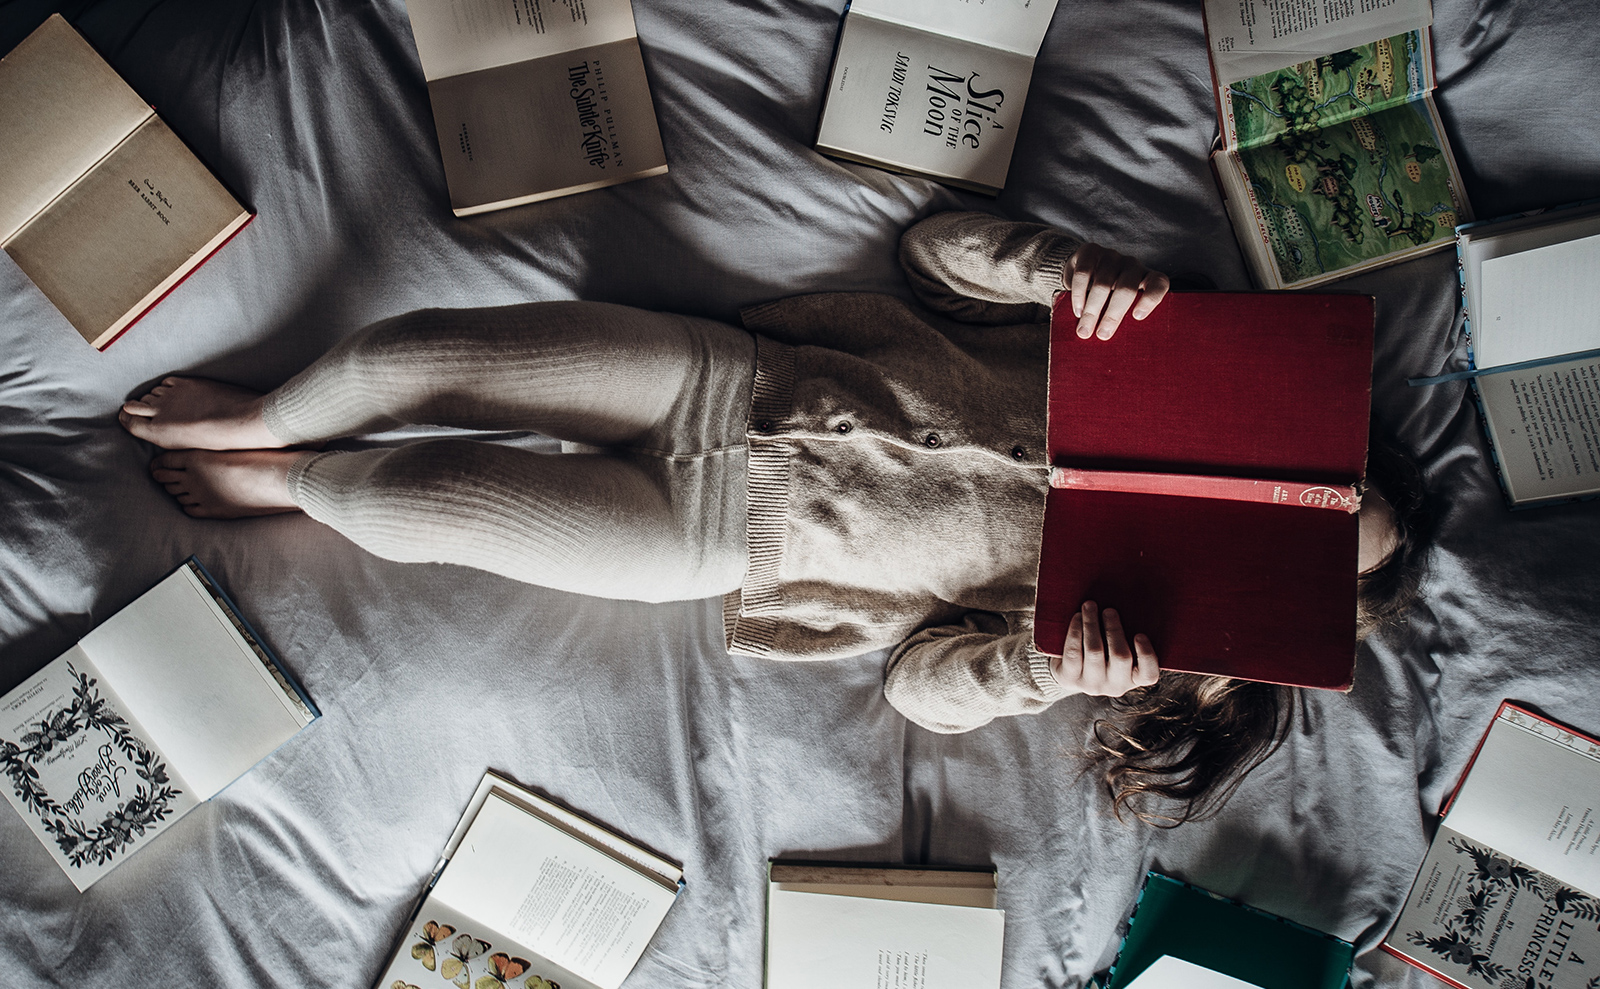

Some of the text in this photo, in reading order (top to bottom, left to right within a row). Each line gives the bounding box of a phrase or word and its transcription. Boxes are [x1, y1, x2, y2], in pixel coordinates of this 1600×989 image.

[839, 67, 849, 91] DOUBLEDAY
[880, 51, 910, 134] SANDI TOKSVIG
[568, 61, 610, 169] The Subtle Knife
[593, 60, 623, 167] PHILIP PULLMAN
[924, 64, 966, 137] Moon
[962, 71, 1004, 149] Slice
[946, 109, 962, 149] OF THE
[992, 121, 1004, 130] A
[1229, 113, 1234, 123] BY
[1232, 130, 1238, 141] ME
[1249, 187, 1262, 220] SHEPARD
[141, 193, 157, 210] RABBIT
[156, 210, 170, 225] BOOK
[1368, 194, 1379, 217] HOUSE
[1375, 196, 1383, 209] MY
[27, 686, 44, 700] PUFFIN
[62, 771, 95, 815] Gables
[97, 766, 127, 802] Anne
[1553, 819, 1562, 829] May
[1572, 823, 1585, 841] Hodgson
[1581, 808, 1593, 823] Frances
[1424, 871, 1442, 904] PUFFIN BOOKS
[1436, 899, 1447, 916] Margery
[1485, 888, 1518, 957] FRANCES HODGSON BURNETT
[1505, 920, 1514, 930] BY
[1518, 904, 1561, 977] PRINCESS
[1539, 920, 1574, 981] LITTLE
[1568, 951, 1584, 964] A
